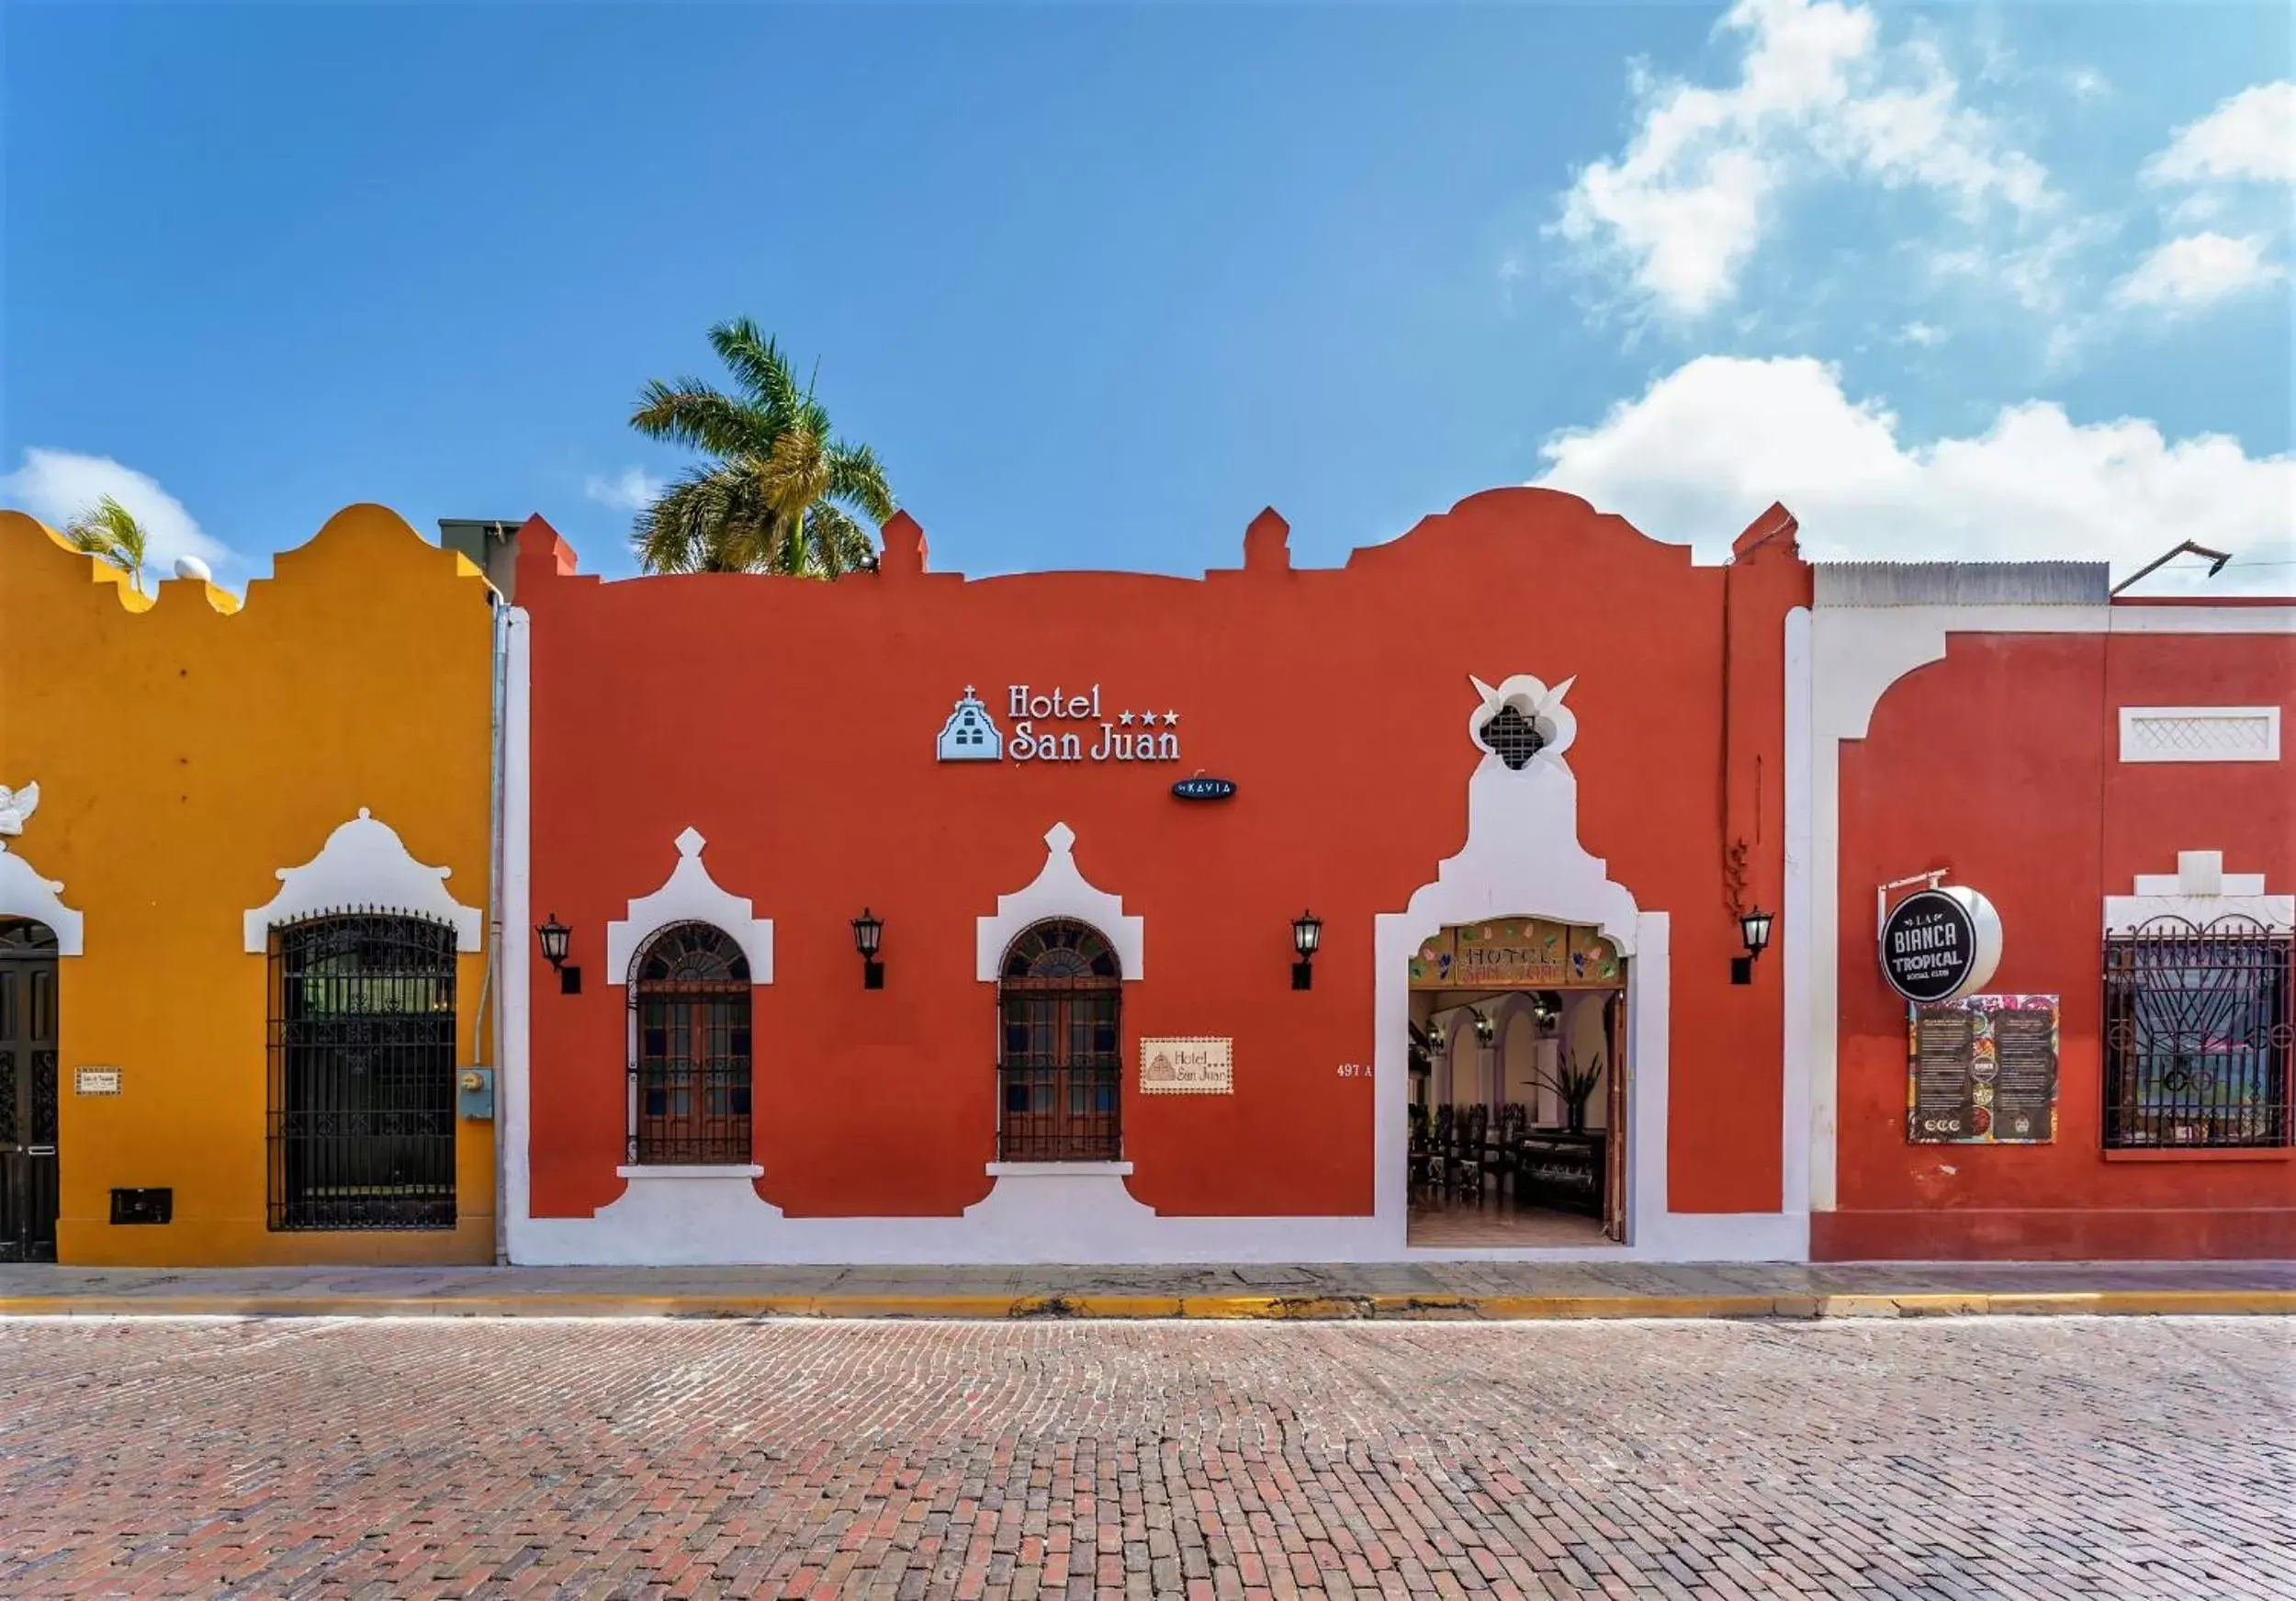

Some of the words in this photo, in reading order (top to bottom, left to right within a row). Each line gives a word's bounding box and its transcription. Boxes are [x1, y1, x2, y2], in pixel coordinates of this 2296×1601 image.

[1008, 683, 1101, 718] Hotel
[1008, 721, 1082, 761] San
[1090, 724, 1180, 761] Juan
[1916, 914, 1931, 926] LA
[1895, 922, 1957, 953] BIANCA
[1467, 948, 1556, 964] HOTEL
[1892, 950, 1963, 972] TROPICAL
[1175, 1051, 1208, 1065] Hotel
[1176, 1066, 1197, 1081] San
[1199, 1066, 1226, 1081] Juan
[1336, 1064, 1360, 1077] 497
